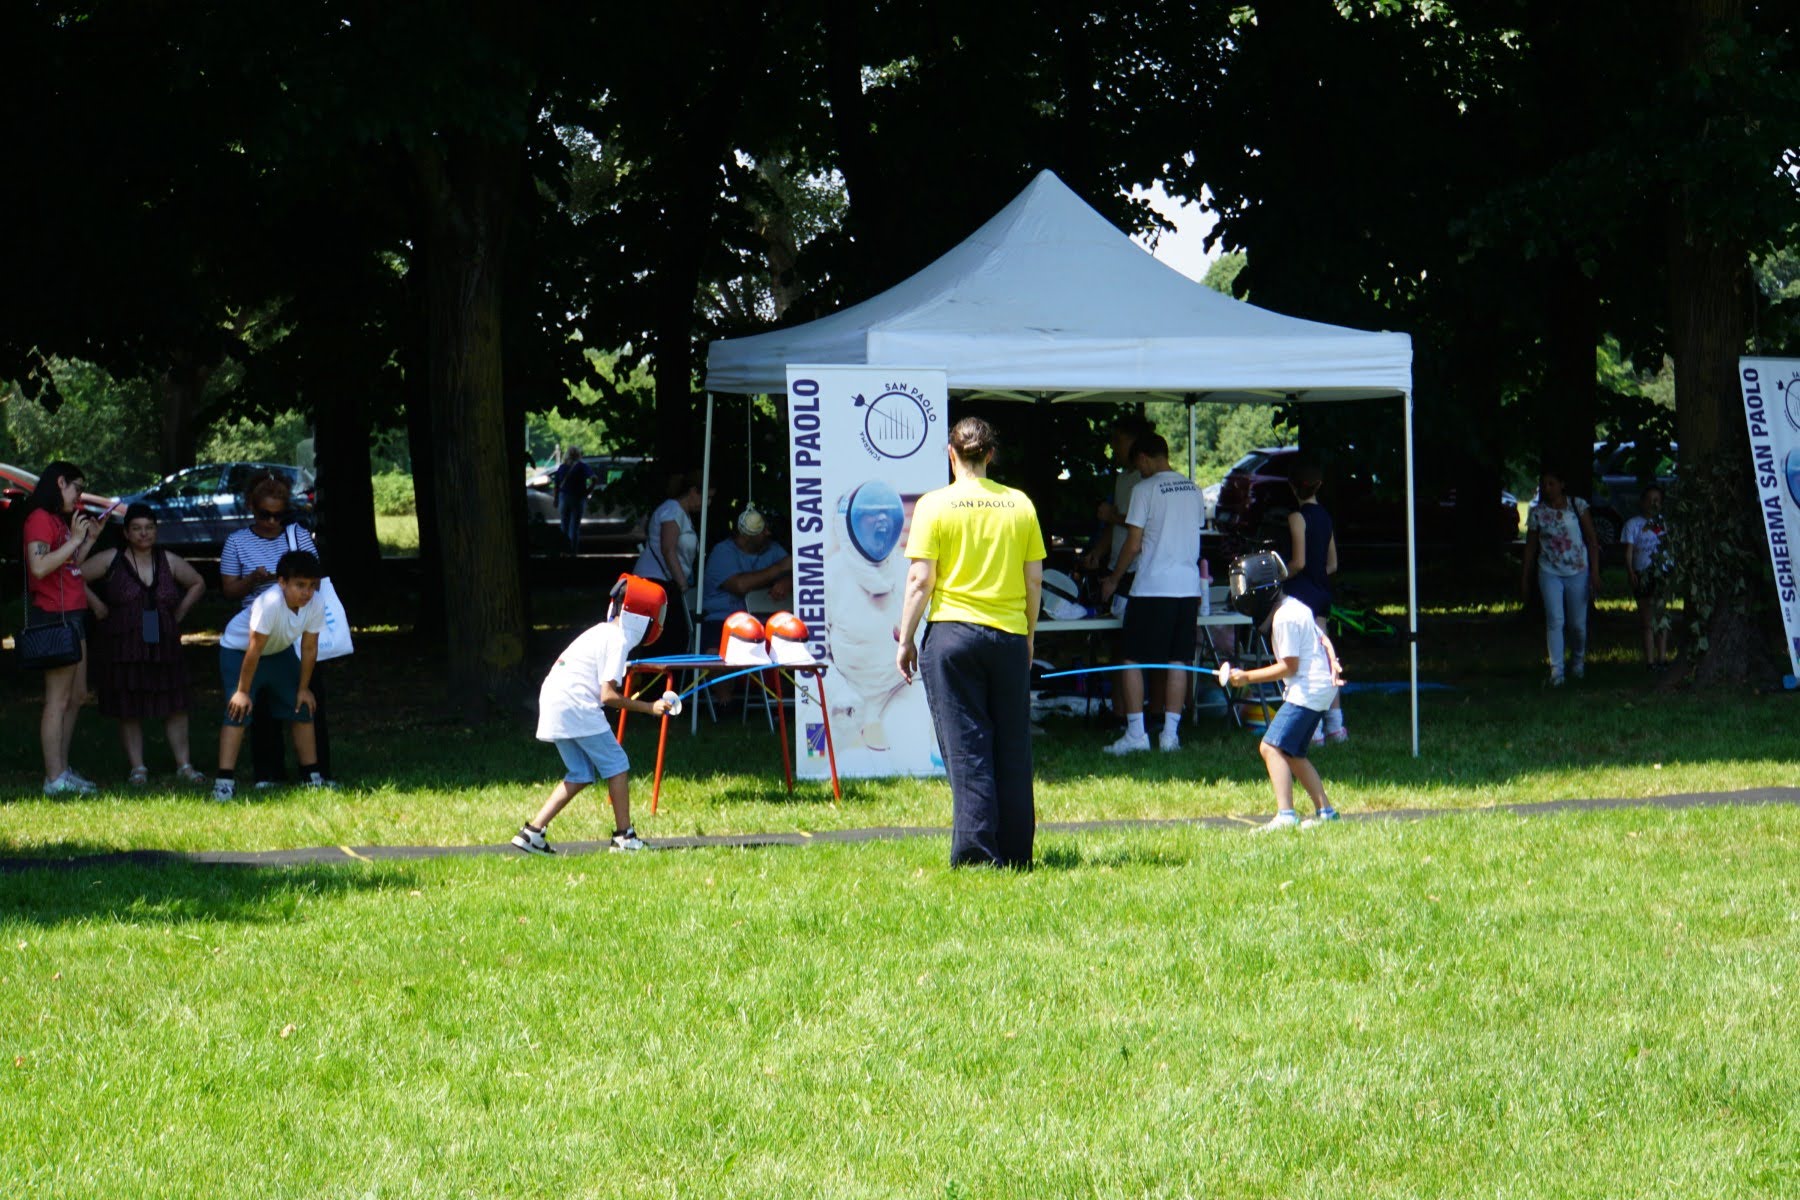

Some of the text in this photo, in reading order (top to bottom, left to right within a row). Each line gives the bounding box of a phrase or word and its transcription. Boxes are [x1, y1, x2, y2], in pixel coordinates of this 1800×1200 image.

[793, 379, 822, 467] PAOLO
[885, 382, 937, 422] SAN PAOLO
[1743, 368, 1769, 438] PAOLO
[859, 431, 882, 462] SCHERMA
[1754, 445, 1778, 489] SAN
[796, 478, 824, 534] SAN
[951, 500, 1015, 509] SAN PAOLO
[1763, 496, 1796, 603] SCHERMA
[801, 685, 809, 705] ASD
